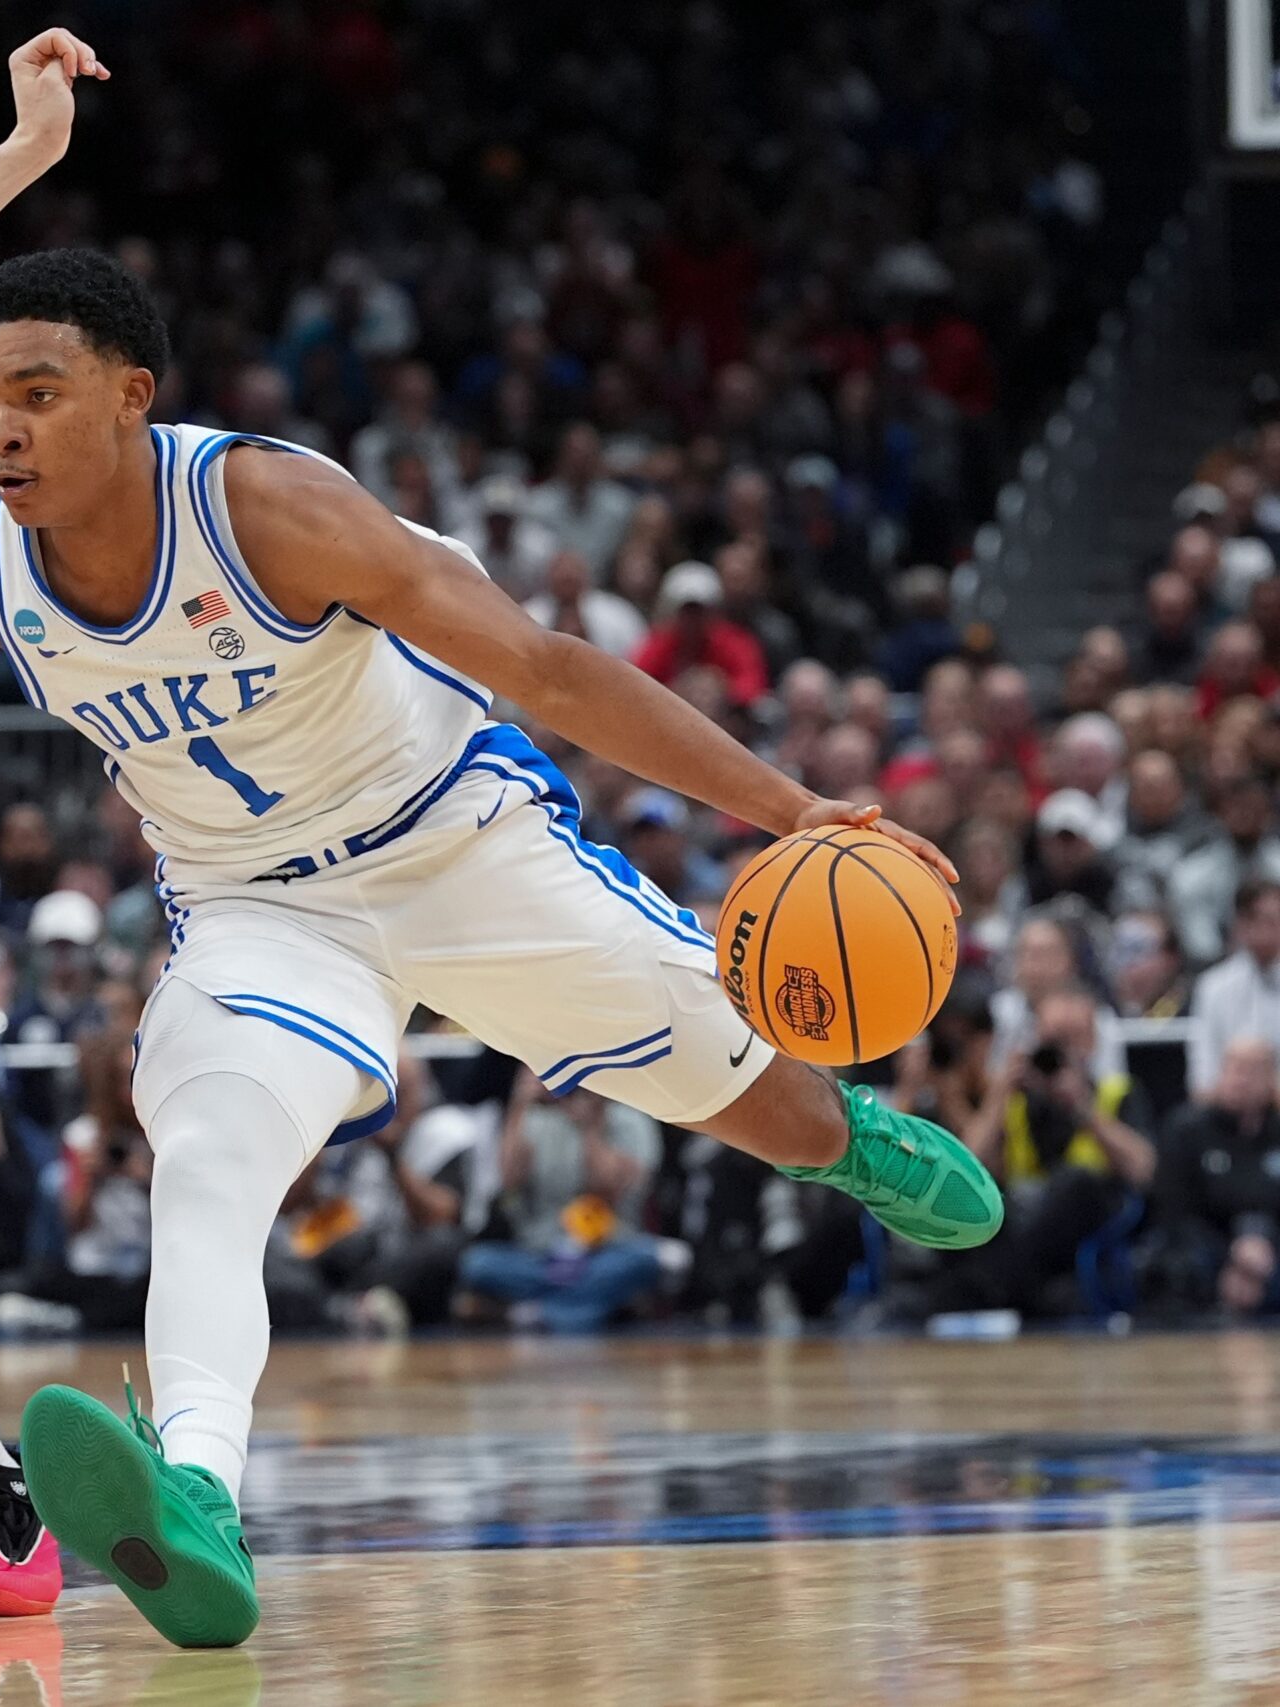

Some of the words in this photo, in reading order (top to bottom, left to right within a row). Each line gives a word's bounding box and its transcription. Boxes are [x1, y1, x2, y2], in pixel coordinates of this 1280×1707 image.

[18, 625, 44, 636] NCAA
[216, 633, 240, 650] ACC
[72, 663, 278, 750] DUKE
[187, 735, 287, 818] 1
[788, 987, 806, 1027] MARCH
[800, 968, 819, 1024] MADNESS
